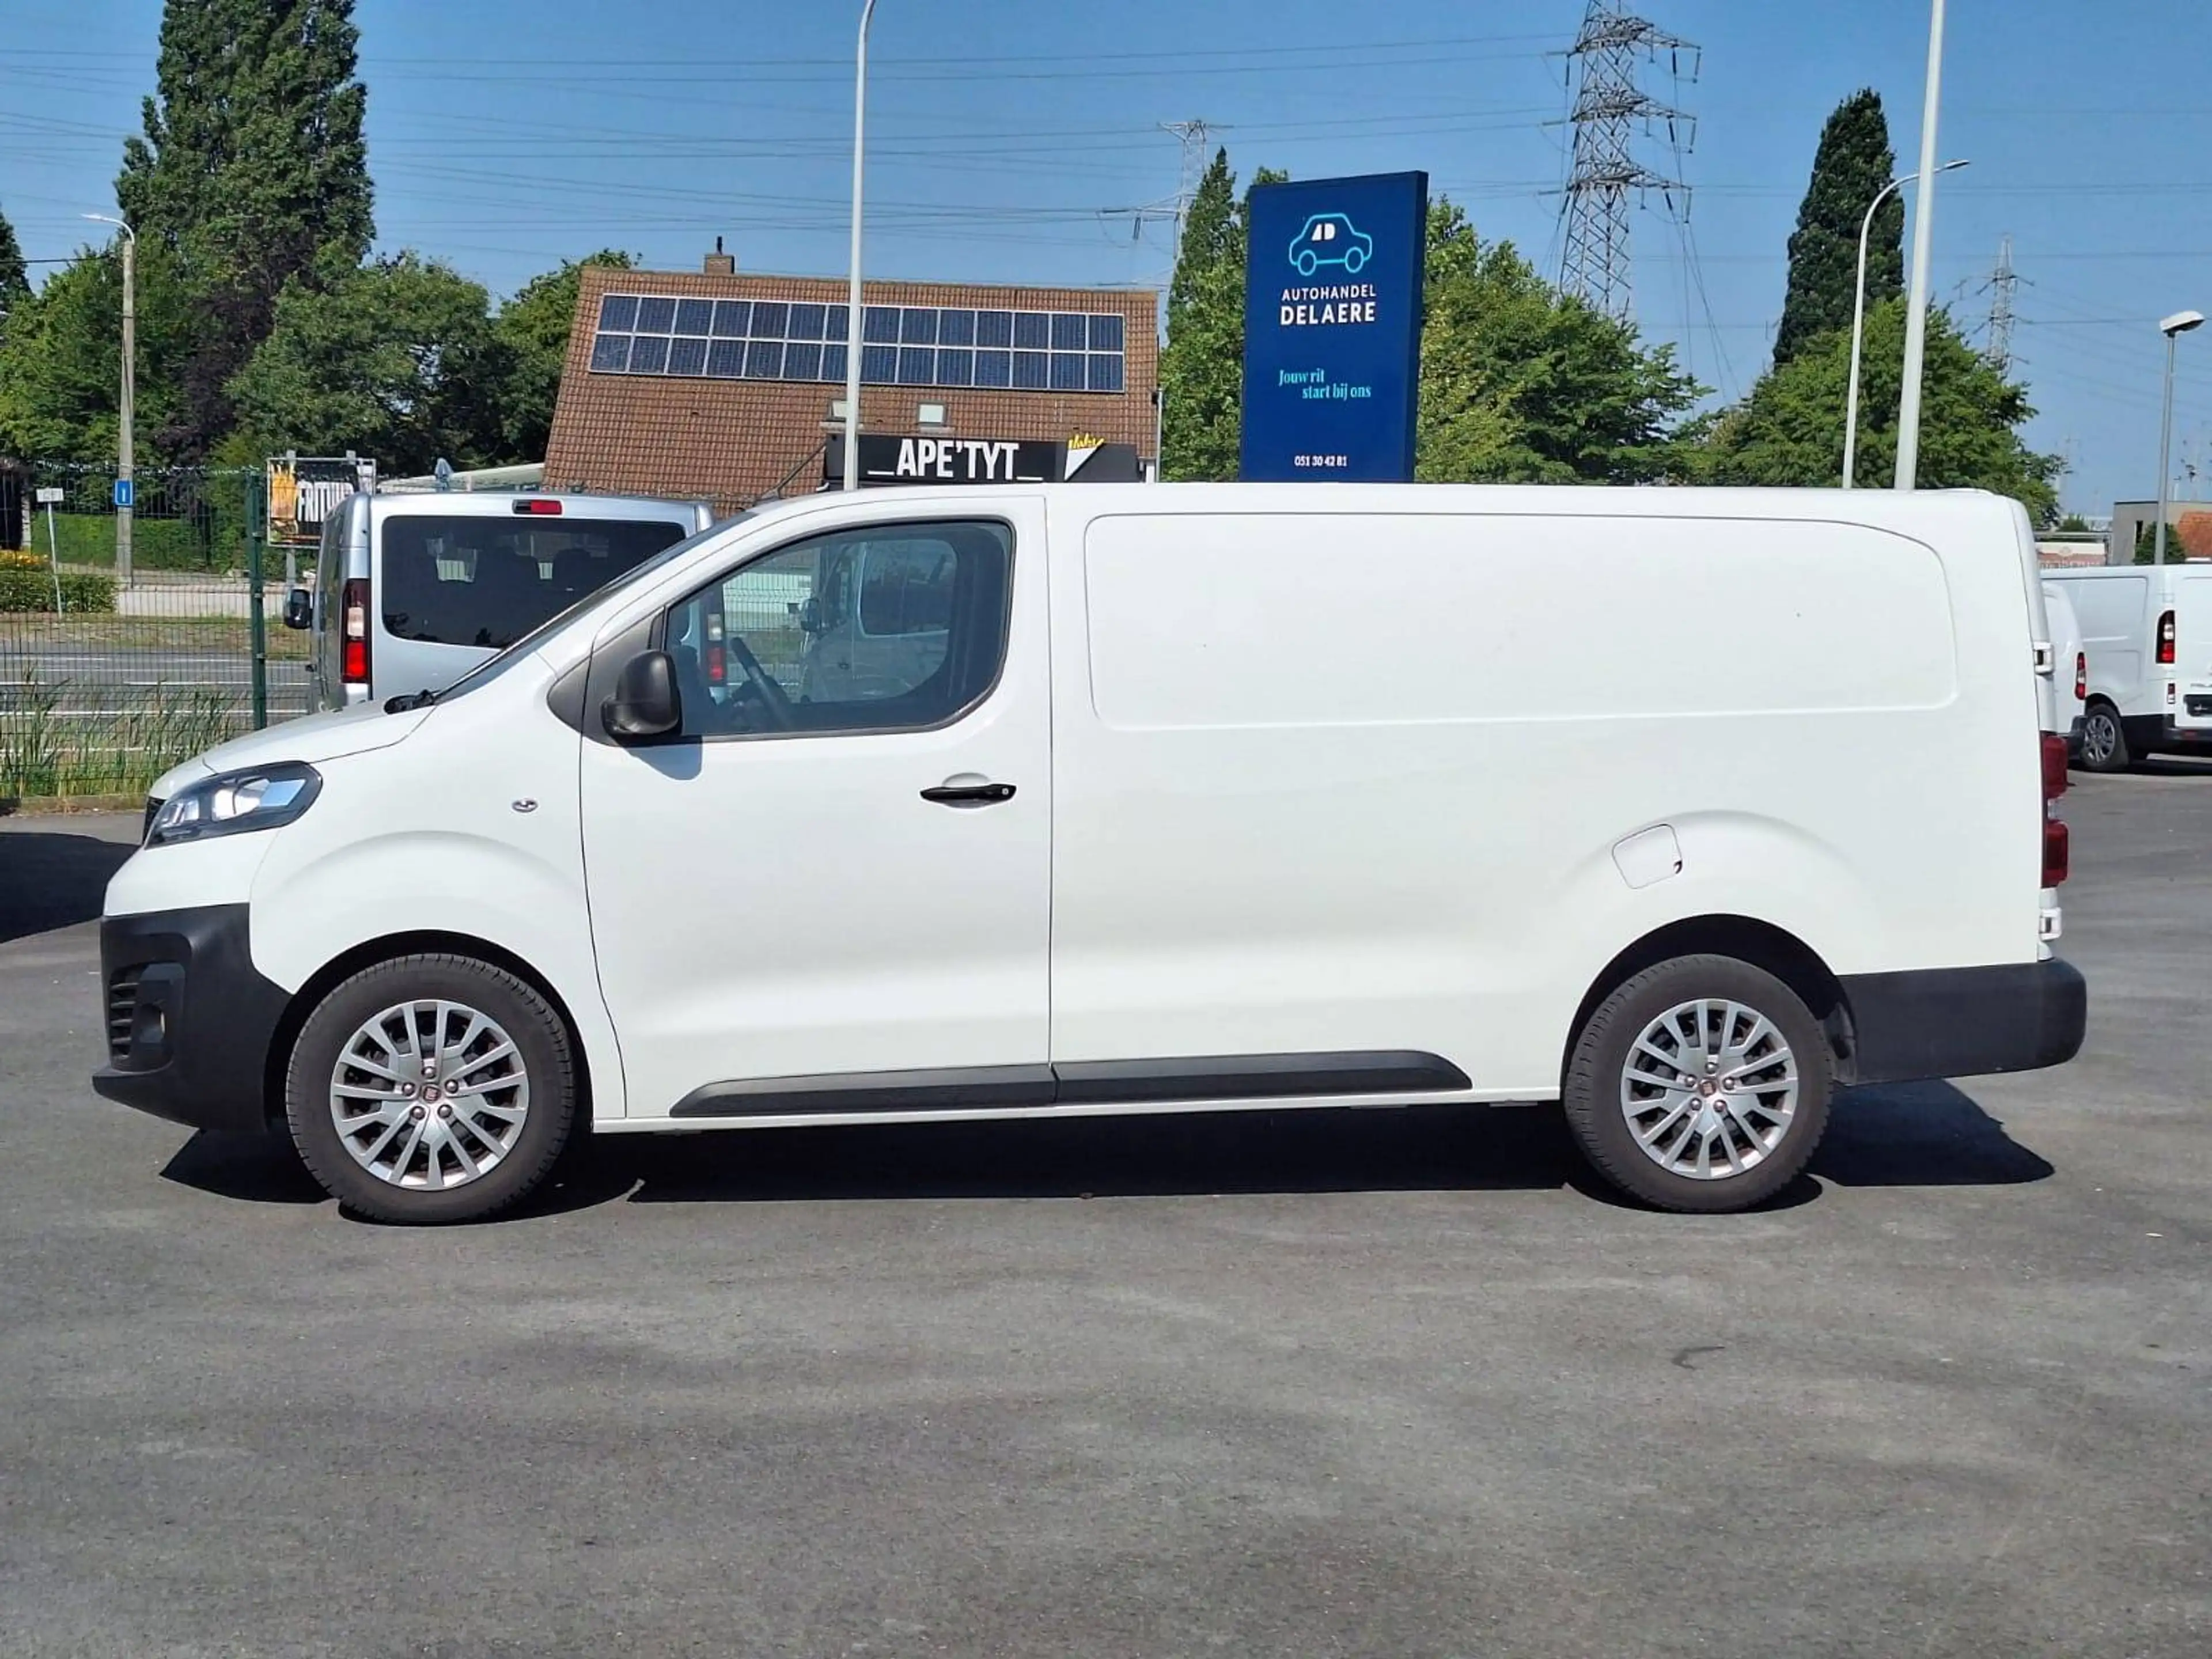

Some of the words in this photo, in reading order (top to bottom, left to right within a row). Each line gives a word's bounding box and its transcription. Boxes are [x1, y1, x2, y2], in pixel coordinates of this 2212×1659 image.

[1281, 284, 1377, 301] AUTOHANDEL
[1280, 301, 1376, 325] DELAERE
[1278, 369, 1309, 387] Jouw
[1302, 385, 1330, 399] start
[1332, 382, 1348, 401] bij
[1350, 385, 1372, 398] ons
[1294, 454, 1310, 467] 051
[1312, 454, 1324, 467] 30
[1324, 454, 1335, 467] 42
